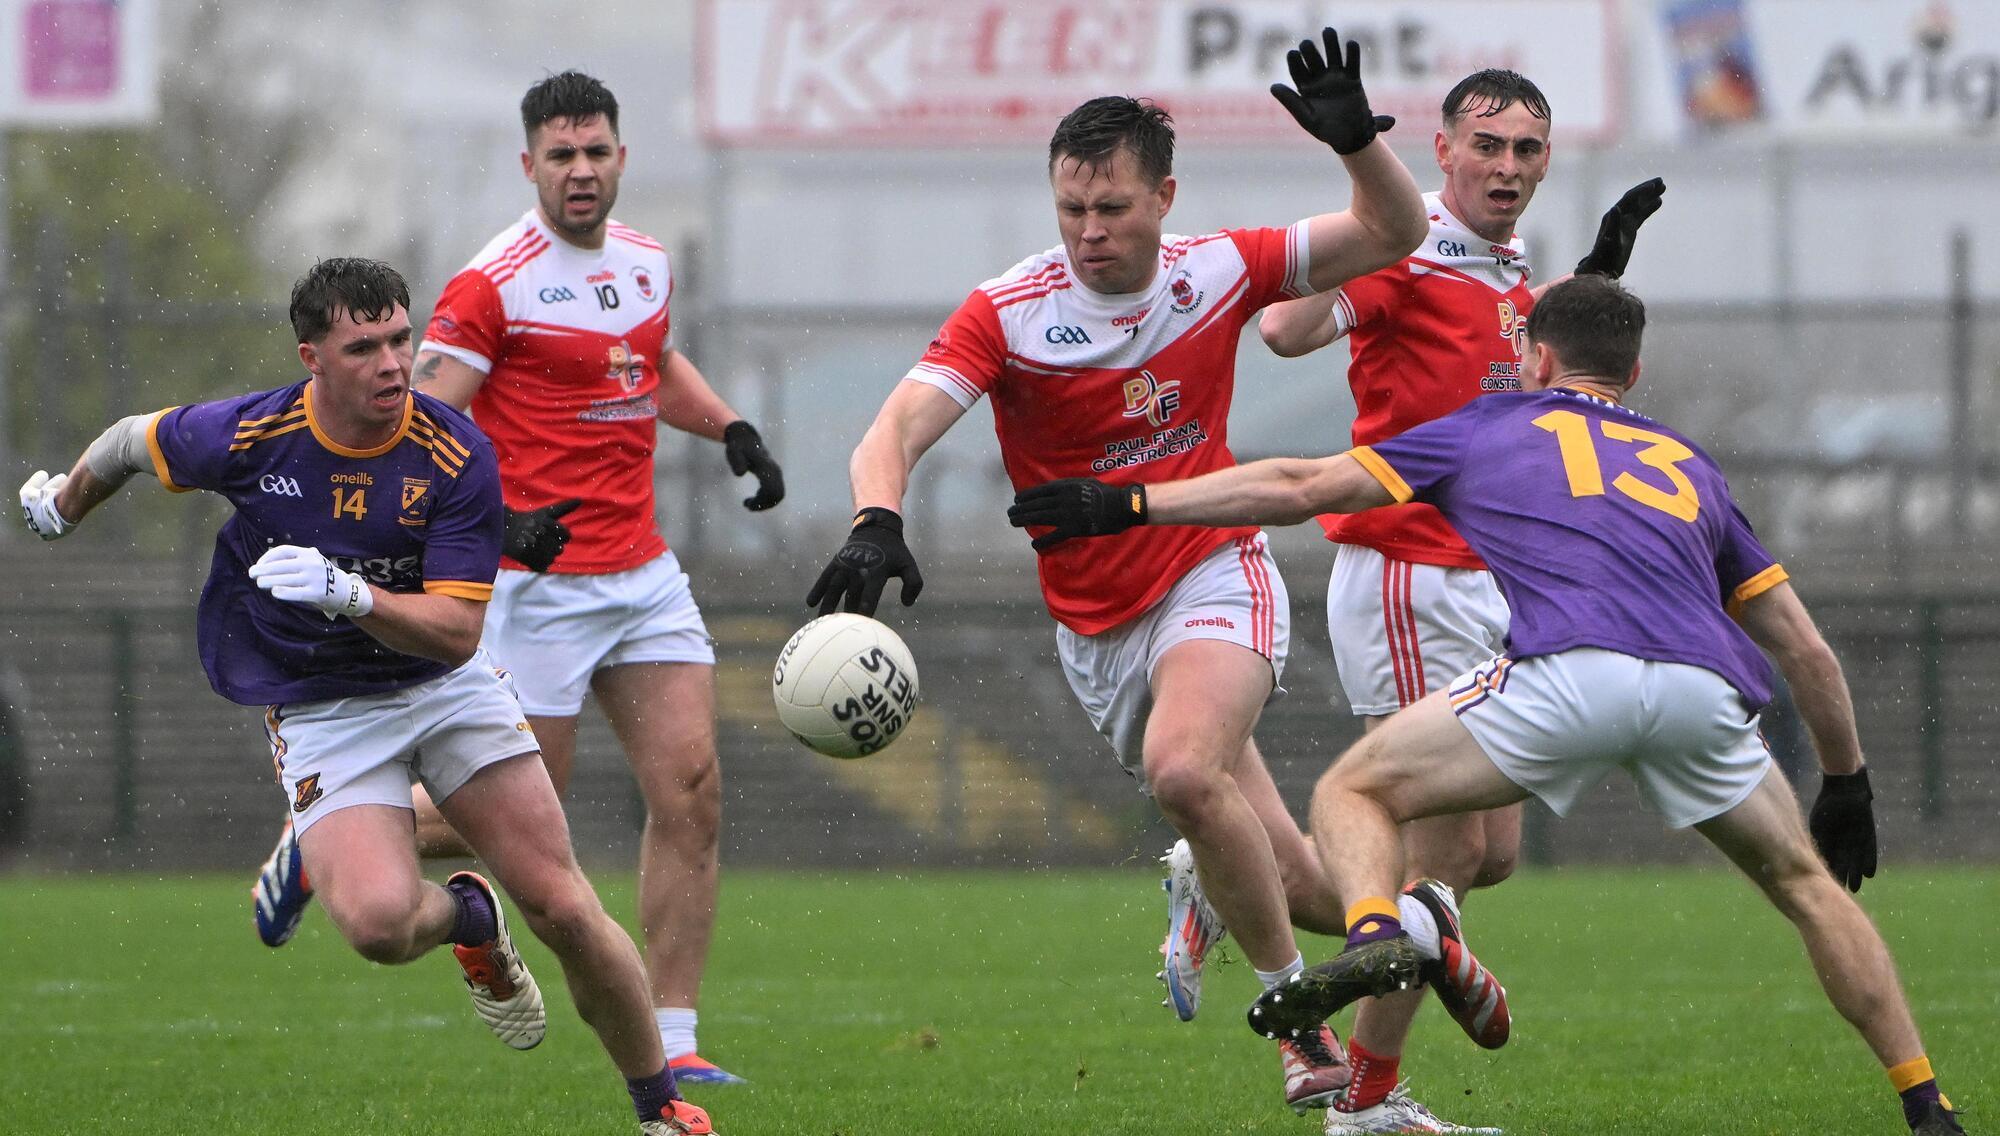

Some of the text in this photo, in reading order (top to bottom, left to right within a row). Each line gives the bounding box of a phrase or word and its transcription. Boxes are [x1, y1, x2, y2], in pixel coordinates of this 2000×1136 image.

[1186, 3, 1430, 78] Prnt
[539, 286, 578, 304] GAA
[594, 284, 620, 311] 10
[1045, 325, 1092, 345] GAA
[1489, 361, 1514, 376] PAUL
[1090, 428, 1209, 473] CONSTRUCTION
[1105, 418, 1200, 456] PAUL FLYNN
[1530, 409, 1701, 523] 13
[259, 473, 304, 498] GAA
[331, 487, 368, 521] 14
[859, 648, 917, 722] AELS
[860, 683, 902, 736] SNR
